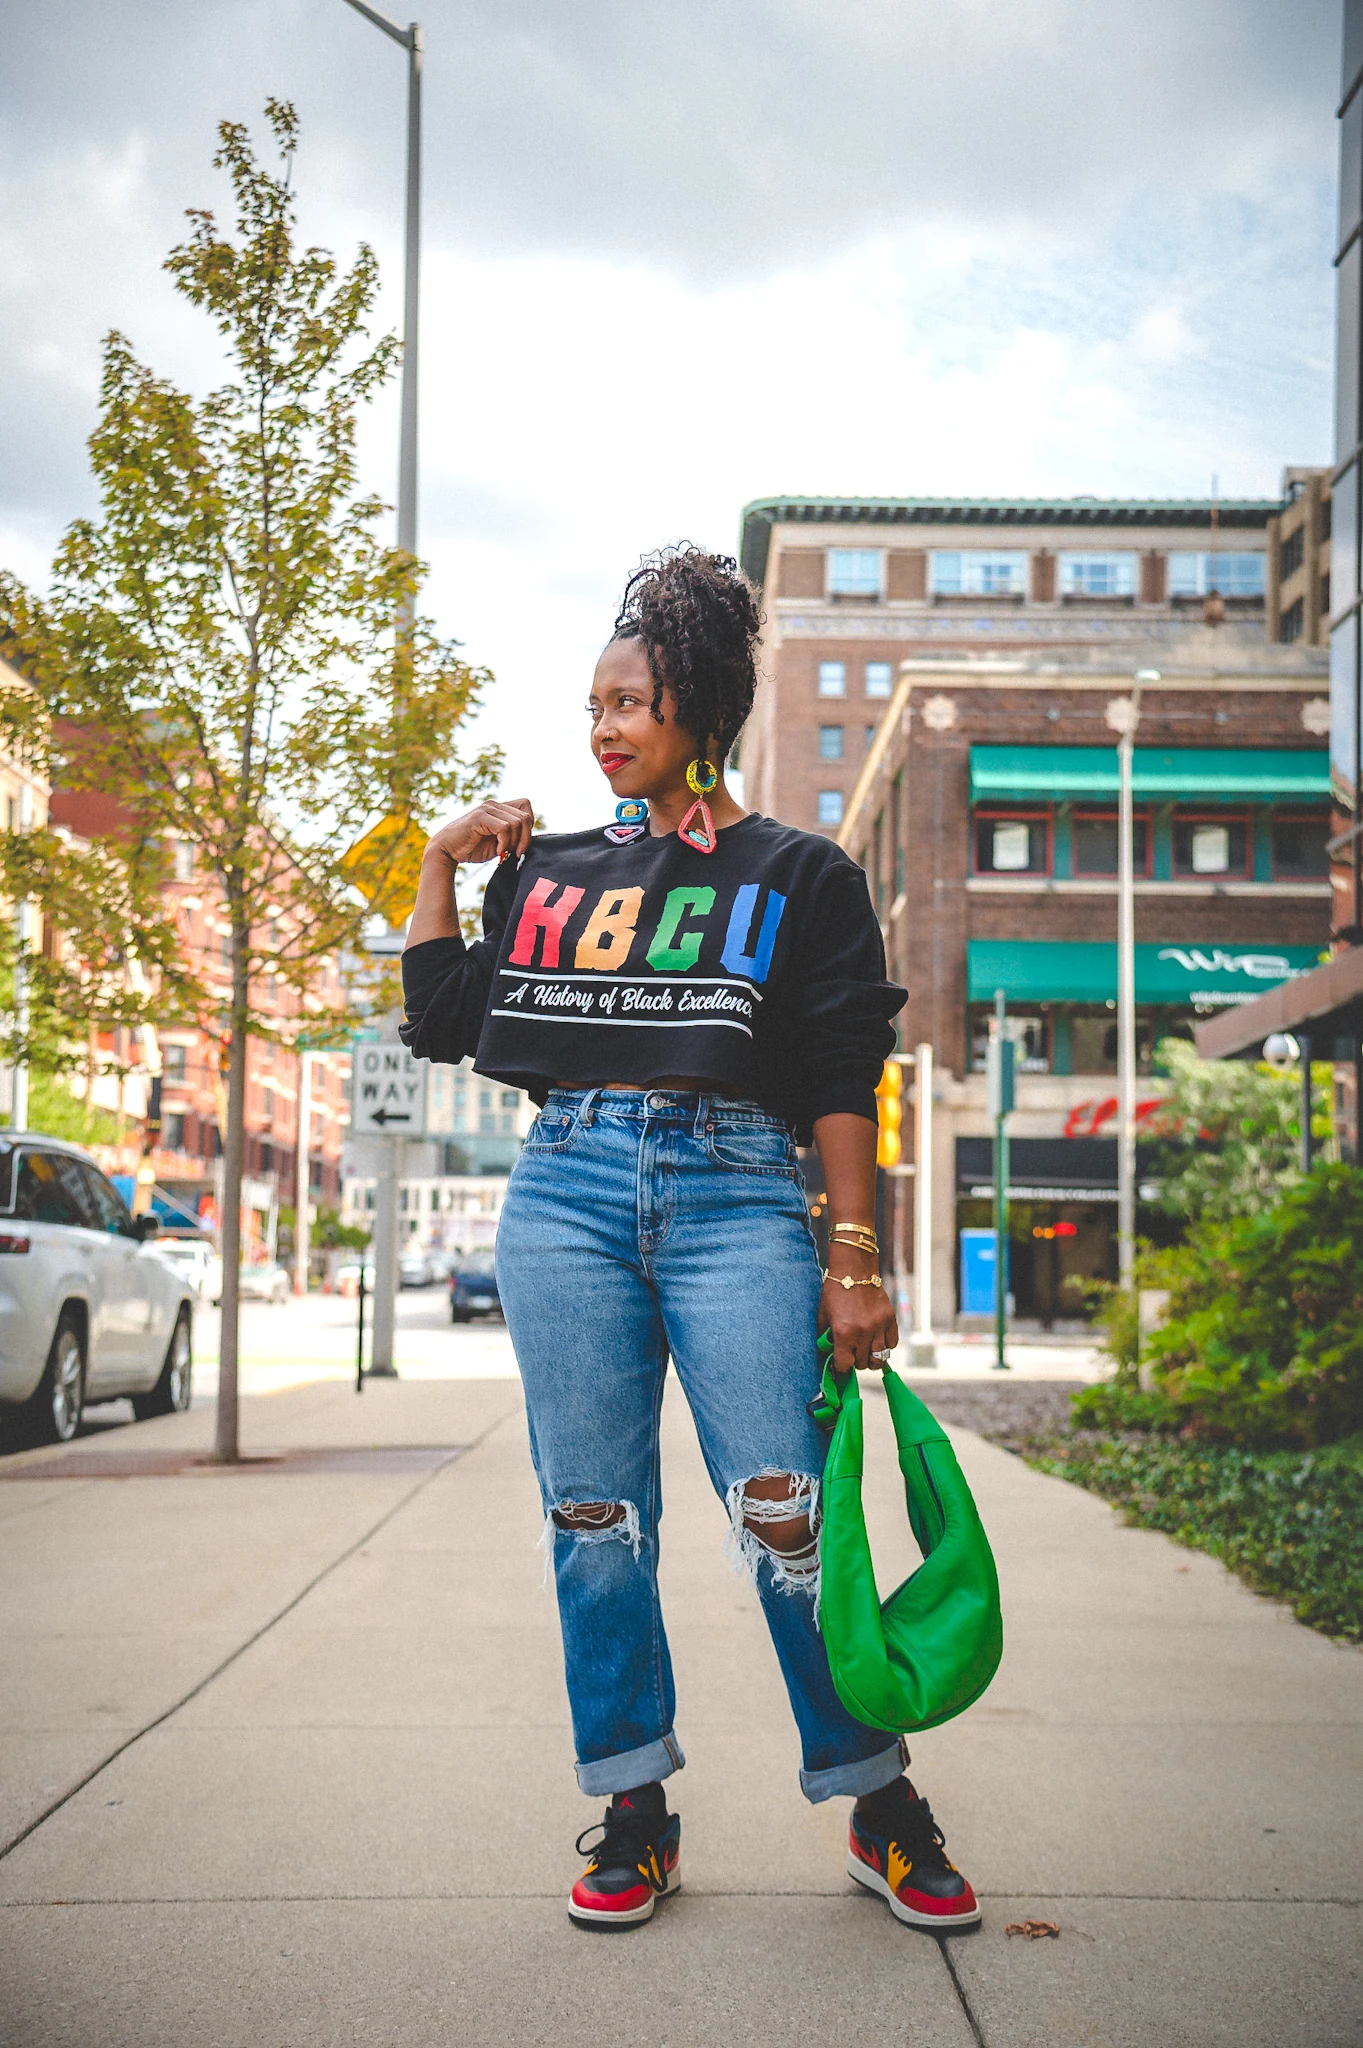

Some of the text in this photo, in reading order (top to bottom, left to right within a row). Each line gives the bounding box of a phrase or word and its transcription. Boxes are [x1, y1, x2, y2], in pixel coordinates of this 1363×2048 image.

[508, 877, 787, 985] HBCU
[504, 982, 529, 1004] A
[533, 984, 594, 1014] History
[598, 986, 618, 1015] of
[621, 987, 674, 1011] Black
[363, 1052, 418, 1074] ONE
[362, 1082, 418, 1102] WAY
